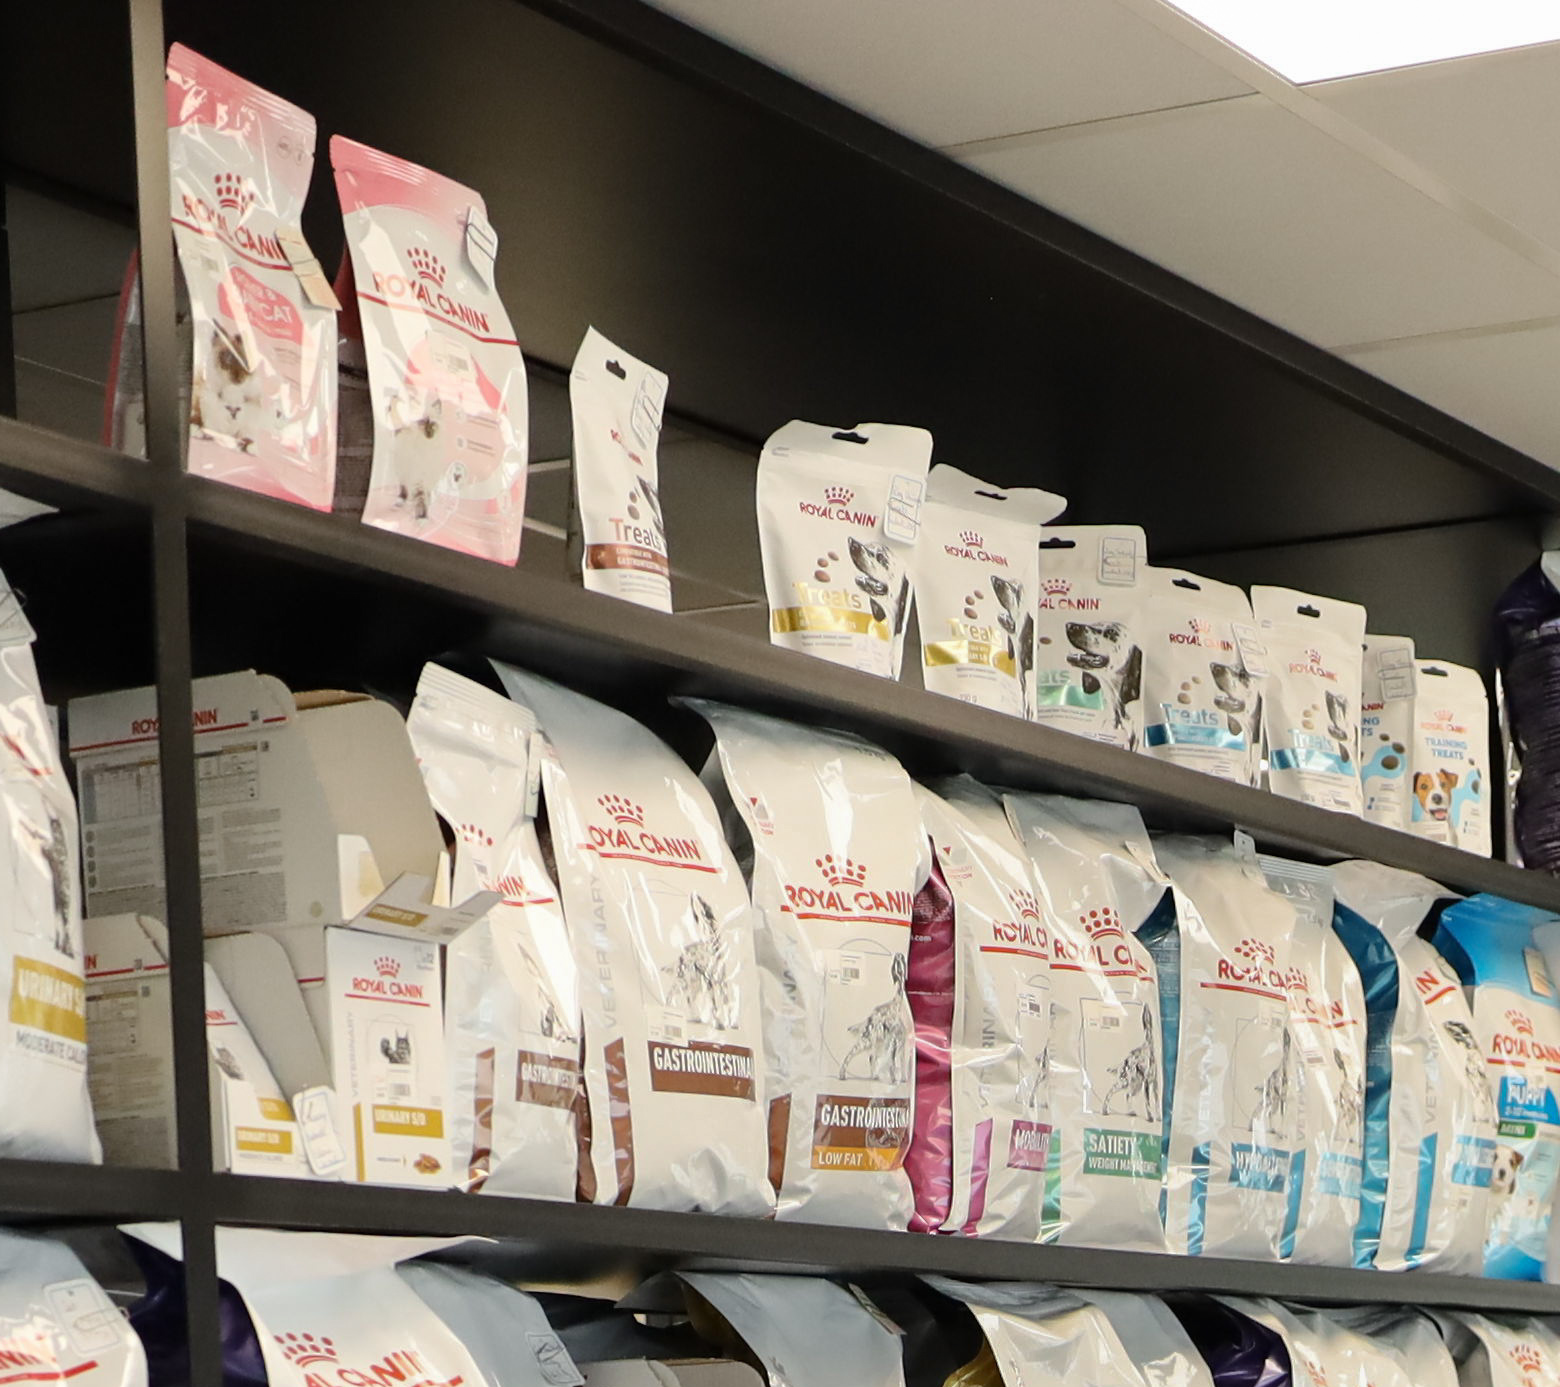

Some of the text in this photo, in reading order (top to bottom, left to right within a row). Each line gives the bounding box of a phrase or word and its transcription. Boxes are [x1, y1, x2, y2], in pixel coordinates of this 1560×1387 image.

[372, 271, 490, 333] ROYAL CANIN
[800, 502, 877, 528] ROYAL CANIN
[945, 544, 1008, 567] ROYAL CANIN
[1057, 598, 1100, 611] CANIN
[1169, 633, 1203, 649] ROYAL
[1162, 703, 1219, 727] Treats
[1424, 736, 1469, 751] TRAINING
[1431, 748, 1465, 761] TREATS
[640, 831, 702, 861] CANIN
[784, 883, 851, 913] ROYAL
[992, 920, 1038, 944] ROYAL
[590, 873, 618, 1031] VETERINARY
[352, 976, 424, 999] ROYAL CANIN
[1491, 1033, 1530, 1060] ROYAL
[1506, 1084, 1549, 1108] PUPPY
[374, 1107, 411, 1125] URINARY
[1499, 1123, 1526, 1137] MINI
[1088, 1135, 1137, 1156] SATIETY
[818, 1151, 864, 1166] LOW FAT
[1088, 1156, 1119, 1170] WEIGHT
